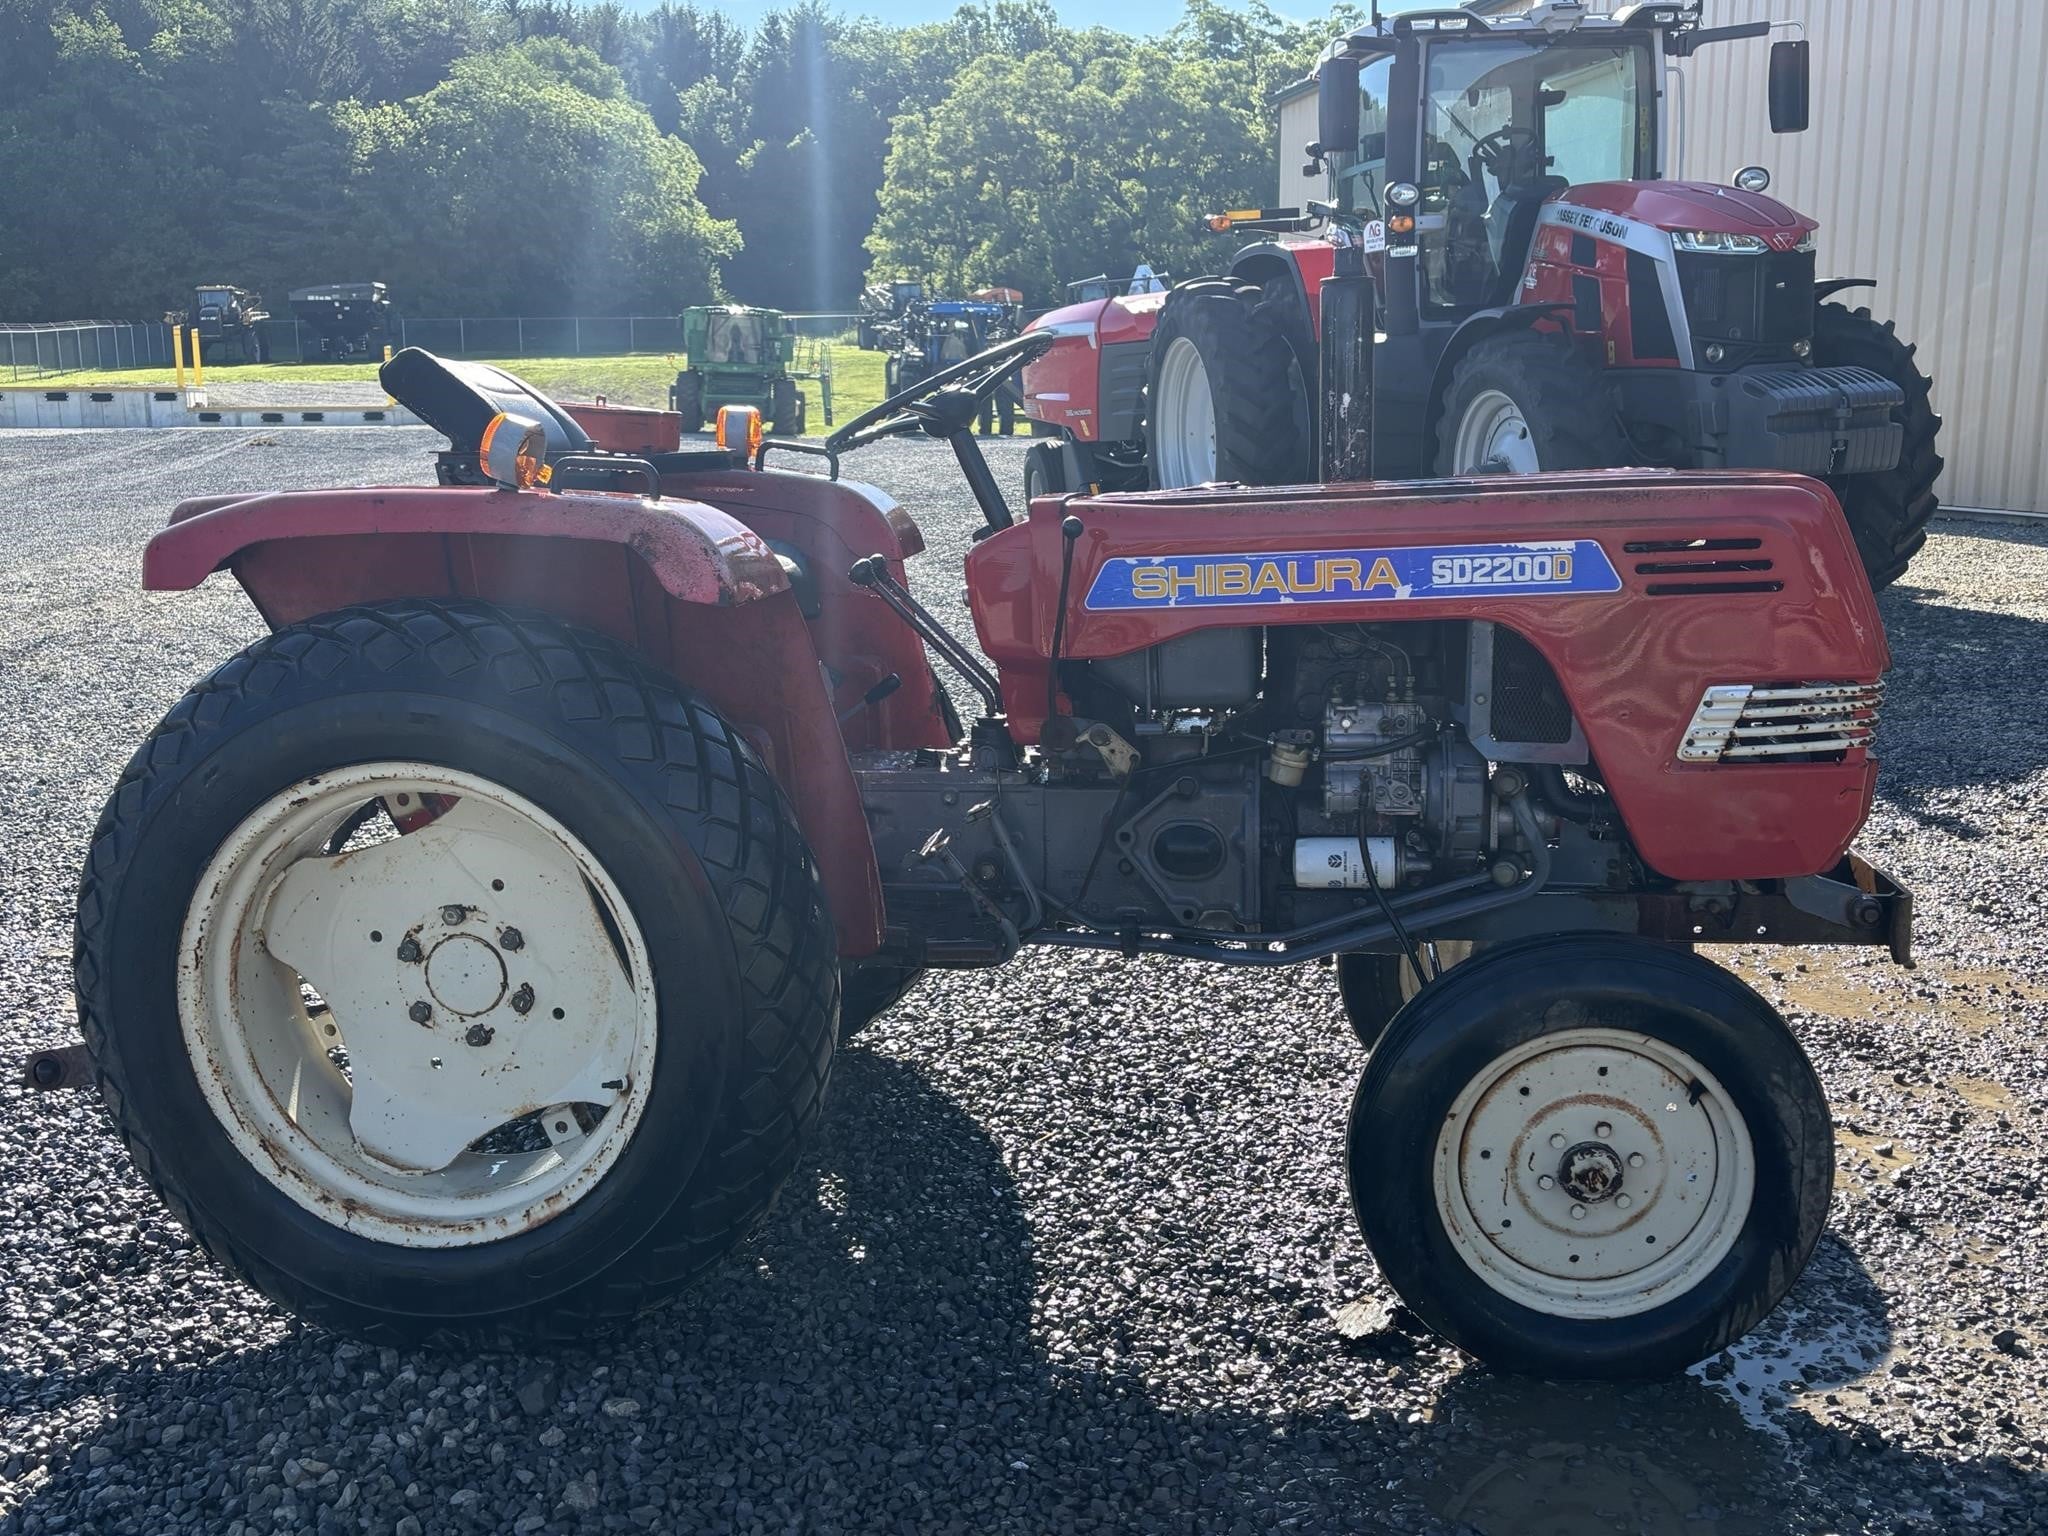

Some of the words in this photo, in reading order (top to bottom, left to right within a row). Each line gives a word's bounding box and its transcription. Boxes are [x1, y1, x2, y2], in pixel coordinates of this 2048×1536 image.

[1556, 207, 1580, 225] ASSEY
[1132, 557, 1402, 599] SHIBAURA
[1432, 554, 1573, 585] SD2200D
